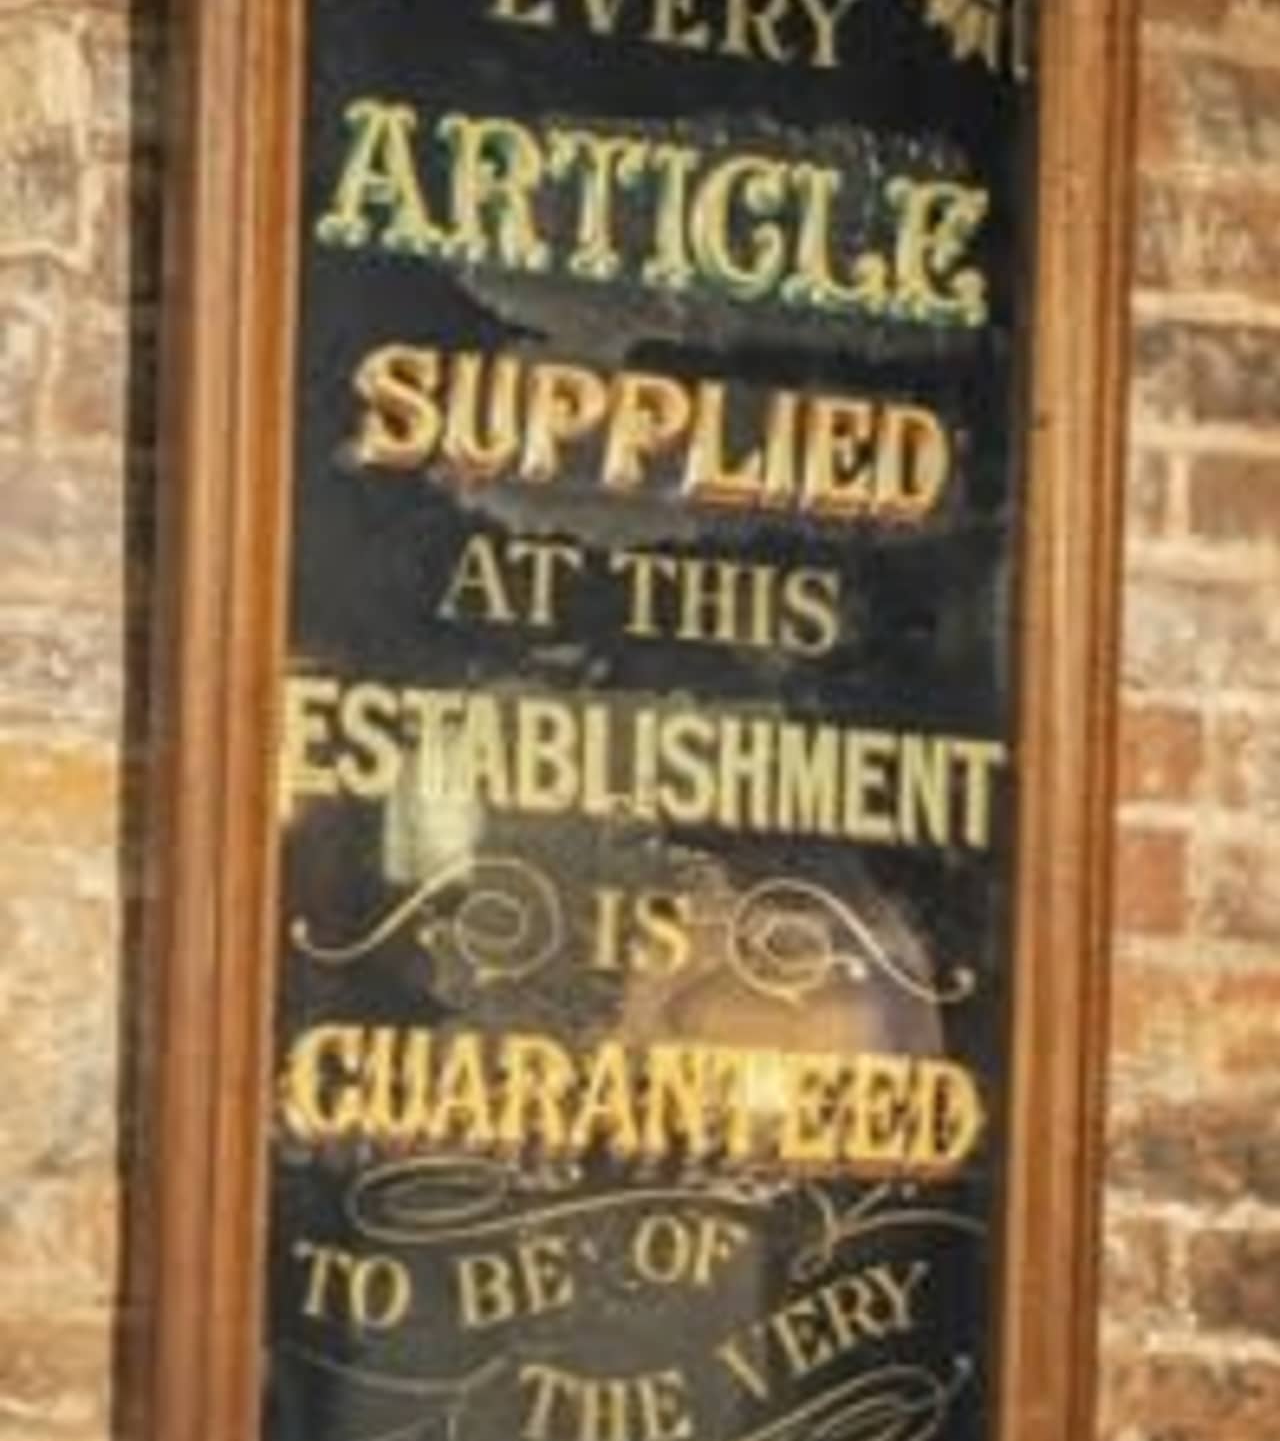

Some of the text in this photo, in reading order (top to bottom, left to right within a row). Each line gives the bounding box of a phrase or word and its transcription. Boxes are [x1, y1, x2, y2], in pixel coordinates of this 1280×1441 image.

[315, 99, 989, 327] ARTICLE
[347, 344, 952, 522] SUPPLIED
[437, 533, 841, 656] AT THIS
[279, 671, 1006, 849] ESTABLISHMENT
[596, 890, 698, 969] IS
[281, 1026, 984, 1168] GUARANTEED
[295, 1215, 754, 1330] TO BE OF
[723, 1258, 929, 1402] VERY
